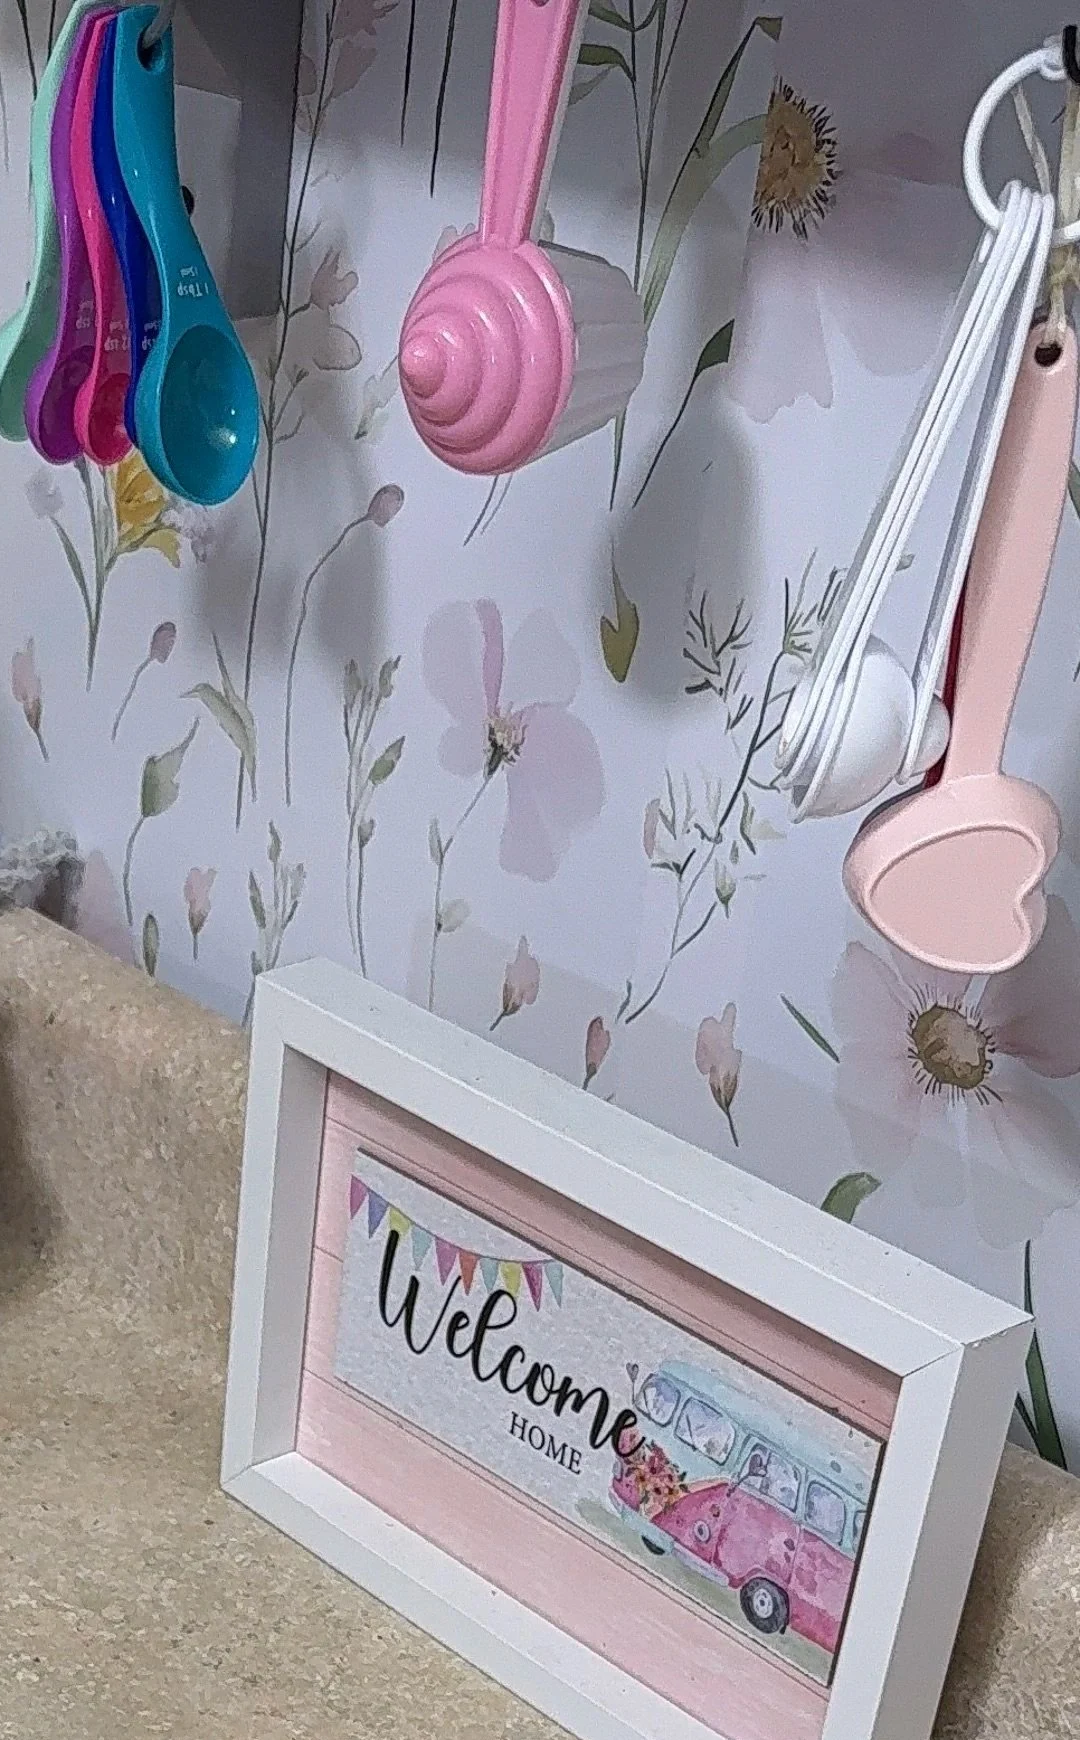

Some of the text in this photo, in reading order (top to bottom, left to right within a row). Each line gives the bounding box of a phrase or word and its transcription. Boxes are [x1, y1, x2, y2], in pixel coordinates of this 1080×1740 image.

[177, 283, 202, 297] Tbsp
[377, 1229, 646, 1459] Welcome
[508, 1411, 582, 1475] HOME
